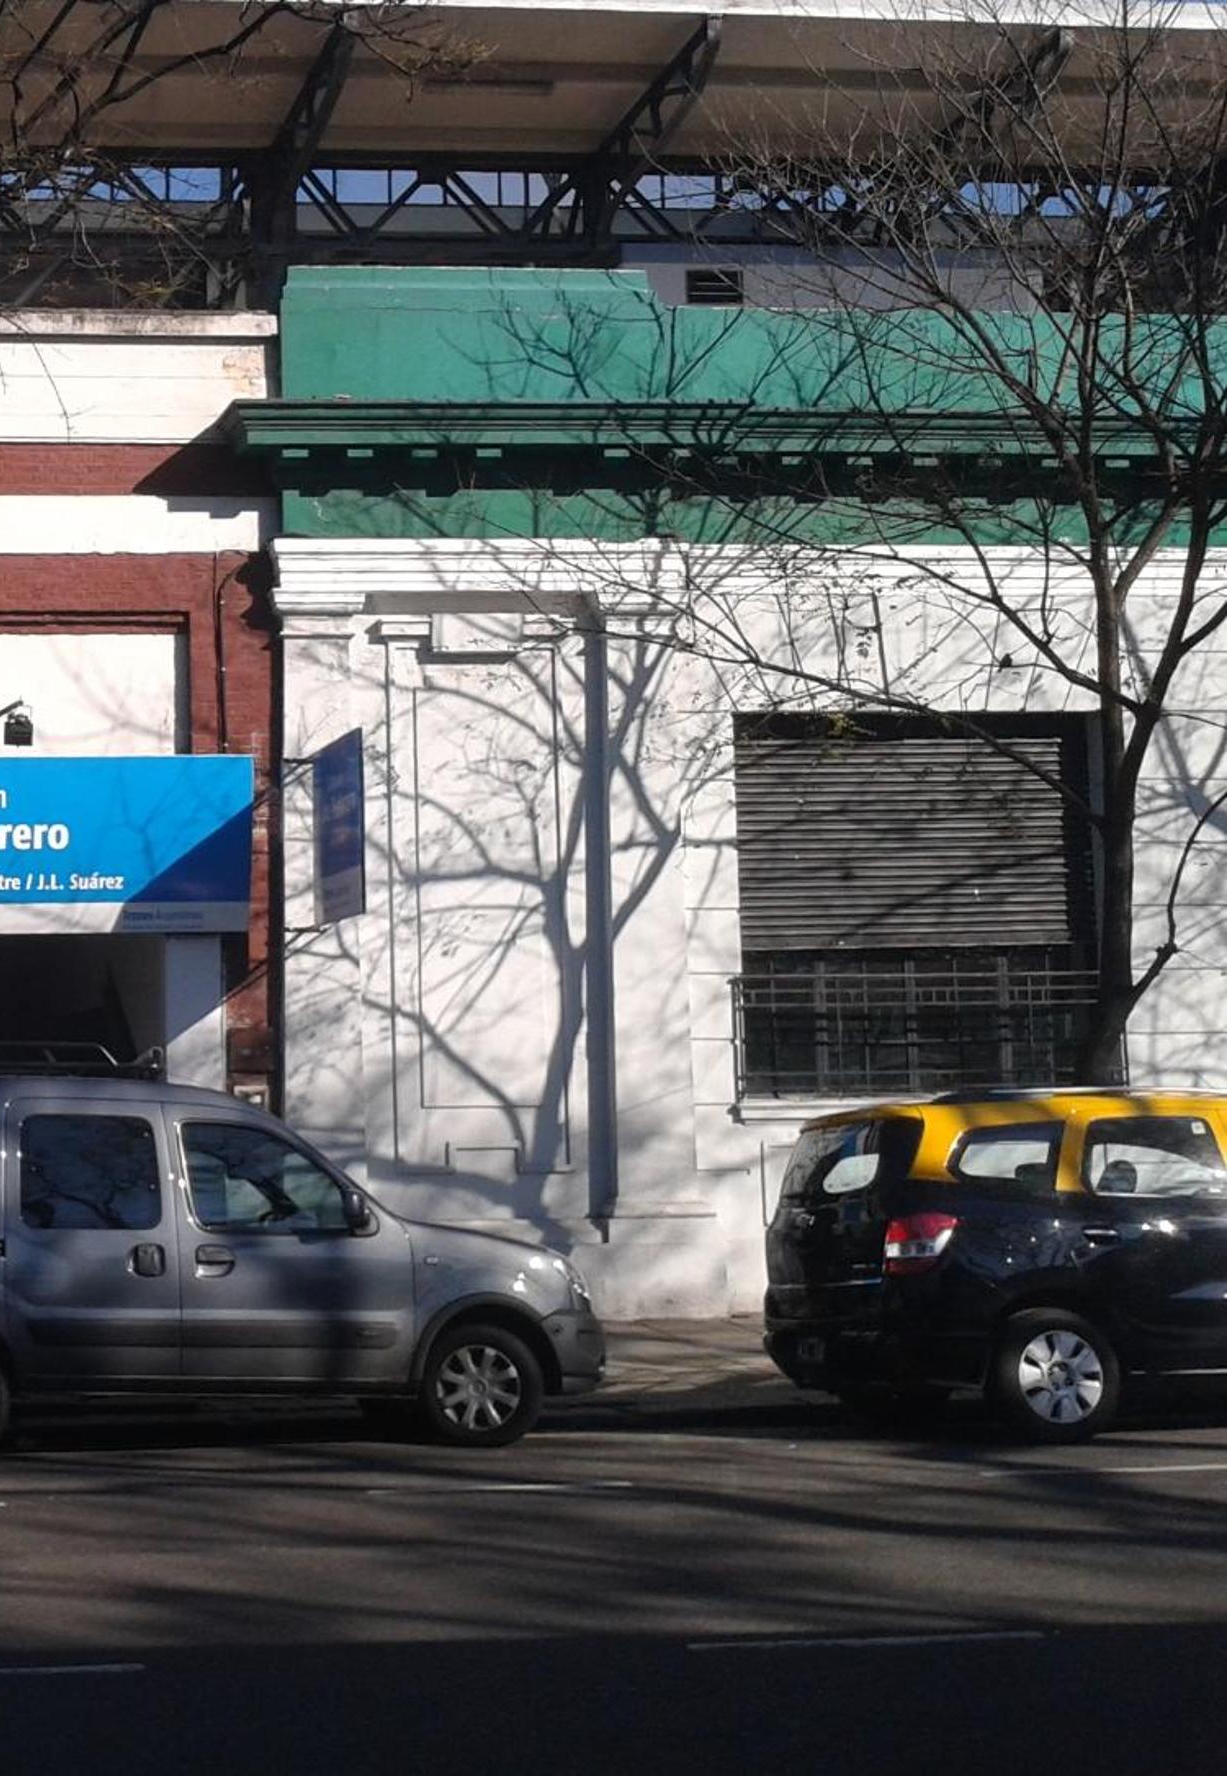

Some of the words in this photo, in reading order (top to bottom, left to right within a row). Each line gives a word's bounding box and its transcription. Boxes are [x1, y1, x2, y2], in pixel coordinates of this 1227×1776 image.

[25, 873, 33, 891] /
[36, 873, 64, 890] J.L.
[69, 871, 124, 890] Suárez
